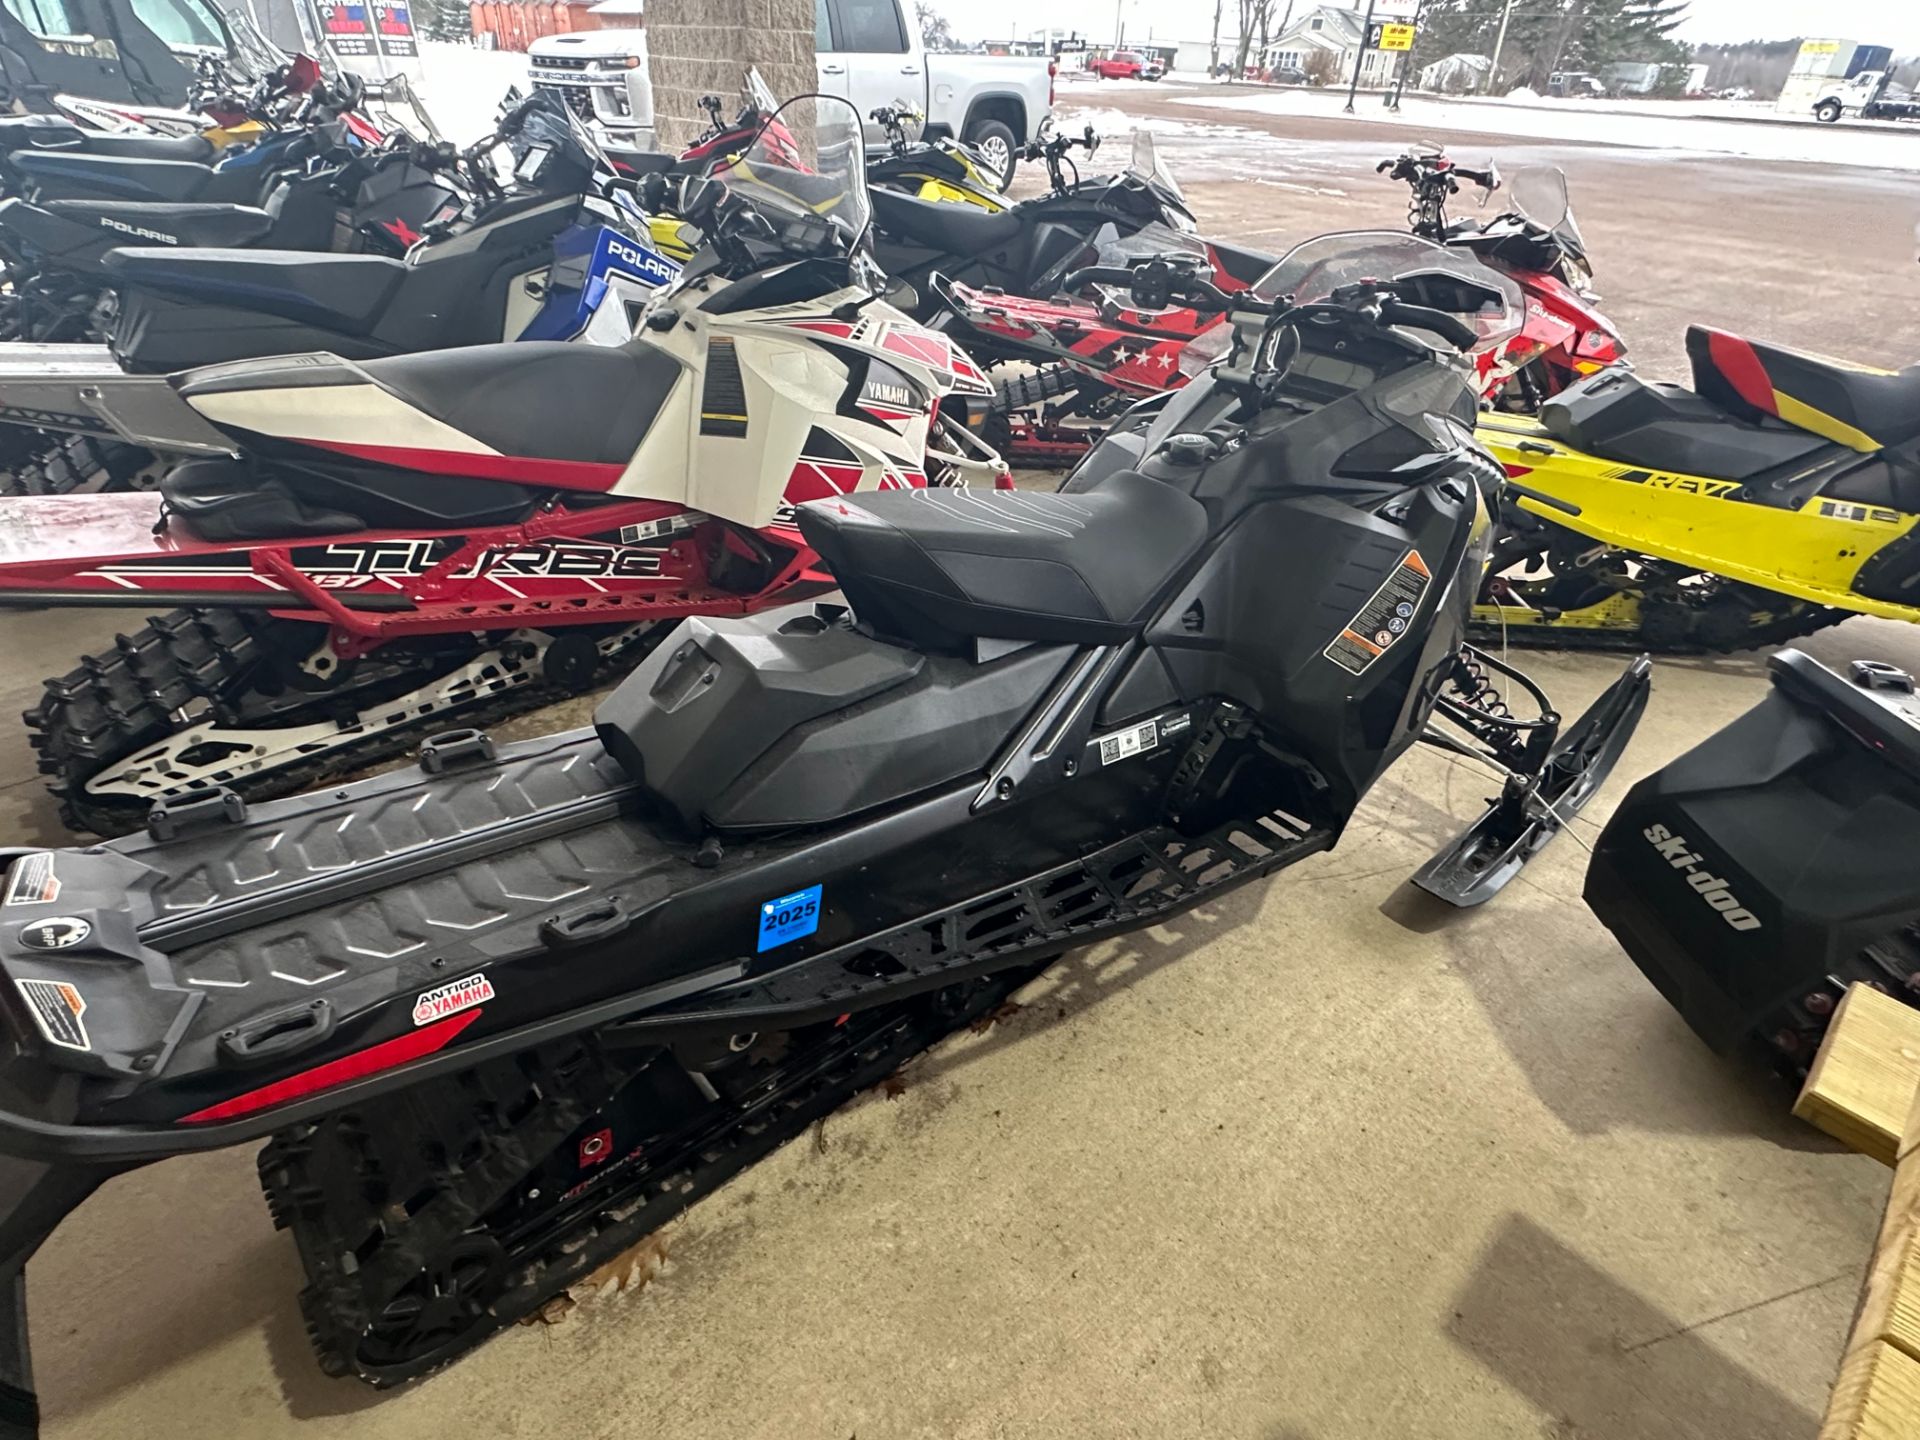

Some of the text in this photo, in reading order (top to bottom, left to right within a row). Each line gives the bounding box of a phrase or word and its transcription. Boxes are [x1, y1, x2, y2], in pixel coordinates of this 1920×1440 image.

[74, 104, 121, 124] POLARIS
[100, 217, 178, 245] POLARIS
[867, 381, 910, 406] YAMAHA
[1643, 824, 1762, 931] ski-doo
[764, 901, 817, 932] 2025
[41, 927, 56, 947] BRP
[420, 976, 483, 1005] ANTIGO
[432, 983, 492, 1015] YAMAHA
